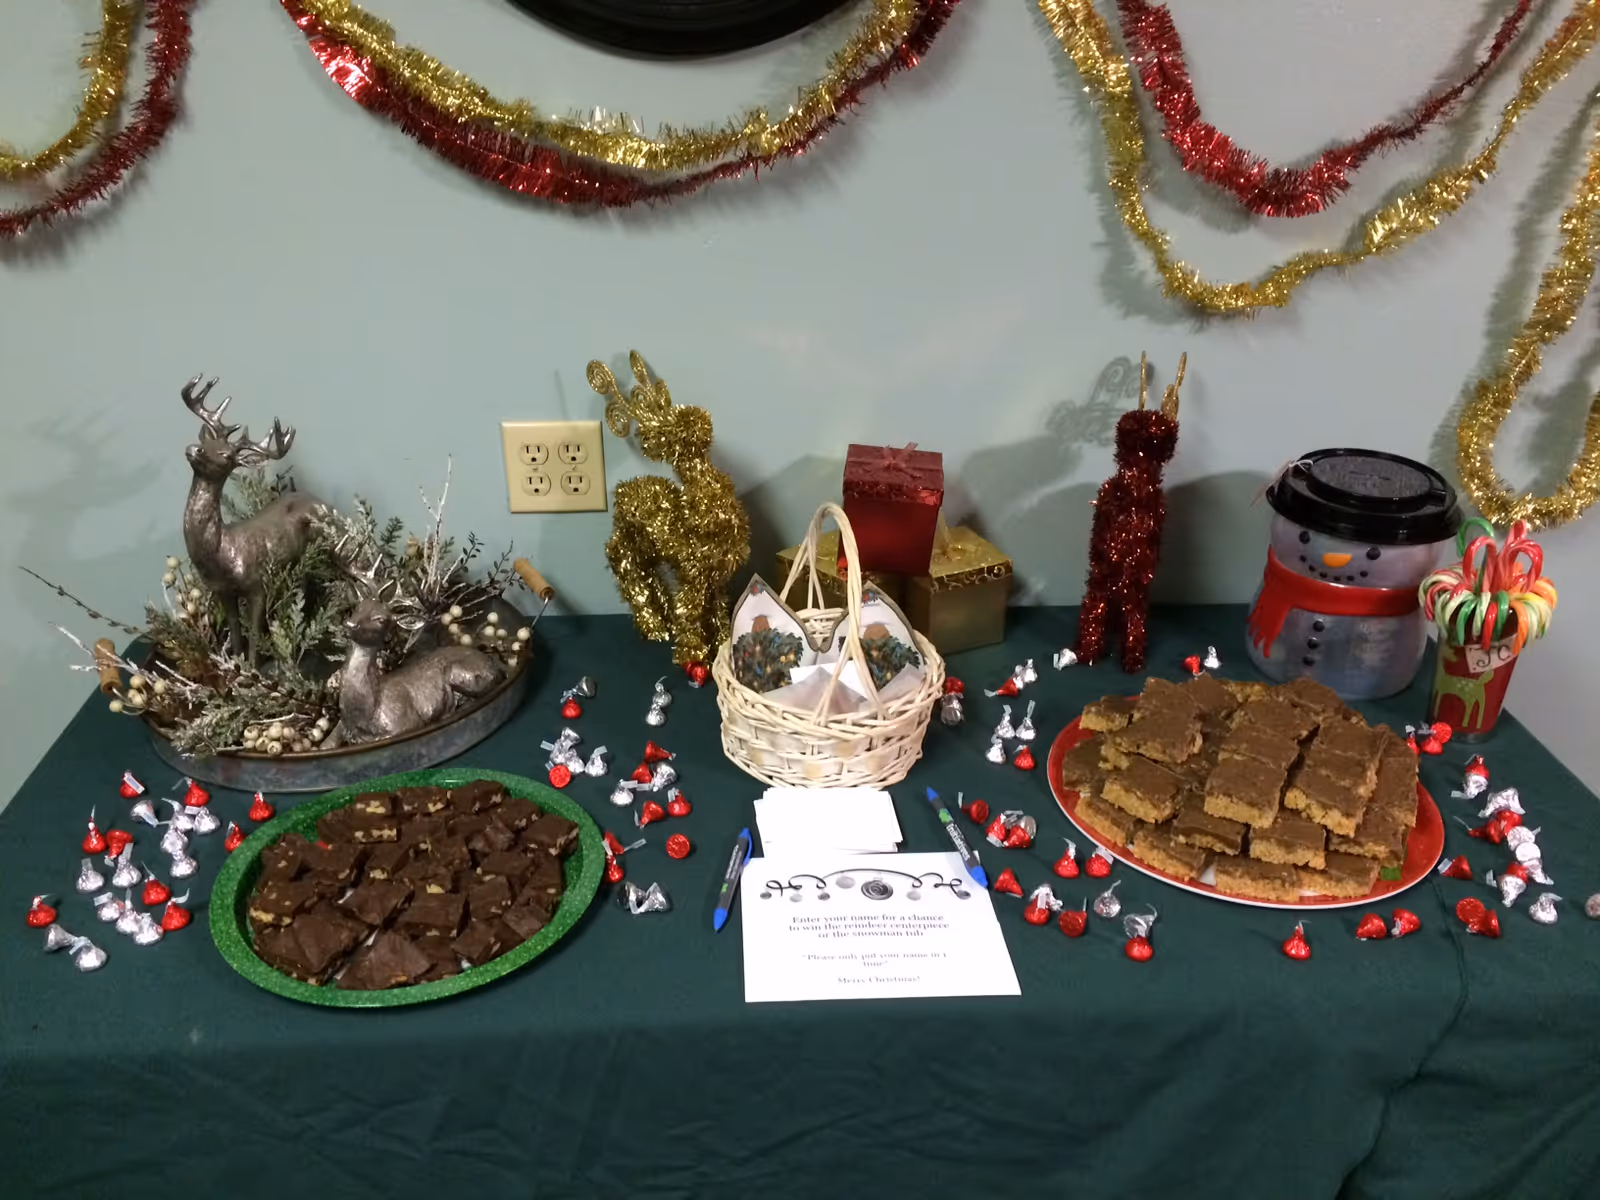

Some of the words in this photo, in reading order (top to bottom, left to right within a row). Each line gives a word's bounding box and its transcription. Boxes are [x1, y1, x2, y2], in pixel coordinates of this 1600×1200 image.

[792, 916, 820, 924] Enter
[823, 914, 847, 923] your
[850, 914, 880, 922] name
[881, 912, 897, 922] for
[907, 912, 944, 922] chance
[802, 923, 822, 931] win
[824, 921, 841, 931] the
[844, 920, 887, 930] reindeer
[889, 921, 950, 931] centerpiece
[832, 929, 850, 938] the
[905, 929, 924, 937] tub
[838, 952, 858, 961] only
[861, 952, 877, 961] put
[879, 952, 900, 960] your
[902, 951, 929, 959] name
[931, 950, 941, 959] in
[837, 976, 867, 984] Merry
